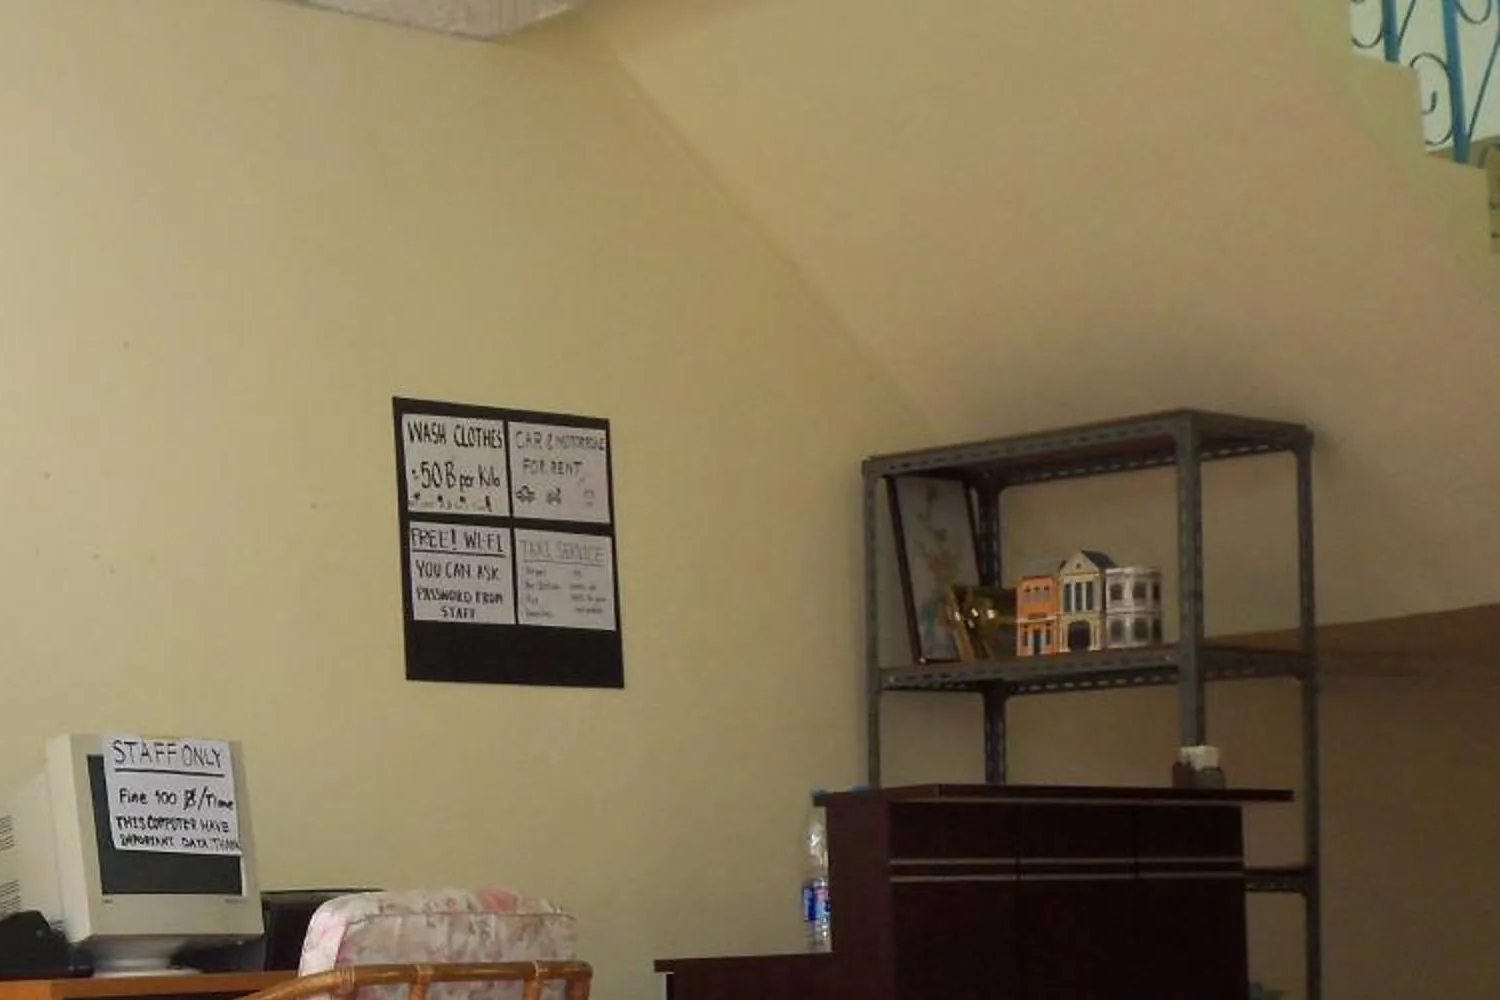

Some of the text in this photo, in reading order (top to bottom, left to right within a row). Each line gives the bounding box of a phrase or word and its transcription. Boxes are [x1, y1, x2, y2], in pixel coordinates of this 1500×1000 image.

[407, 421, 502, 448] WASH CLOTHES
[516, 430, 542, 449] CAR
[523, 457, 583, 476] FOR RENT
[411, 527, 504, 553] FREE! WI-FI
[415, 559, 501, 582] YOU CAN ASK
[416, 586, 504, 605] PASSWORD FROM
[441, 605, 476, 619] STAFF
[113, 739, 222, 768] STAFF ONLY
[119, 787, 149, 805] Fine
[154, 788, 177, 805] 100
[116, 815, 230, 833] THIS COMPUTER HAVE
[119, 833, 176, 848] IMPORTANT
[181, 836, 209, 849] DATA
